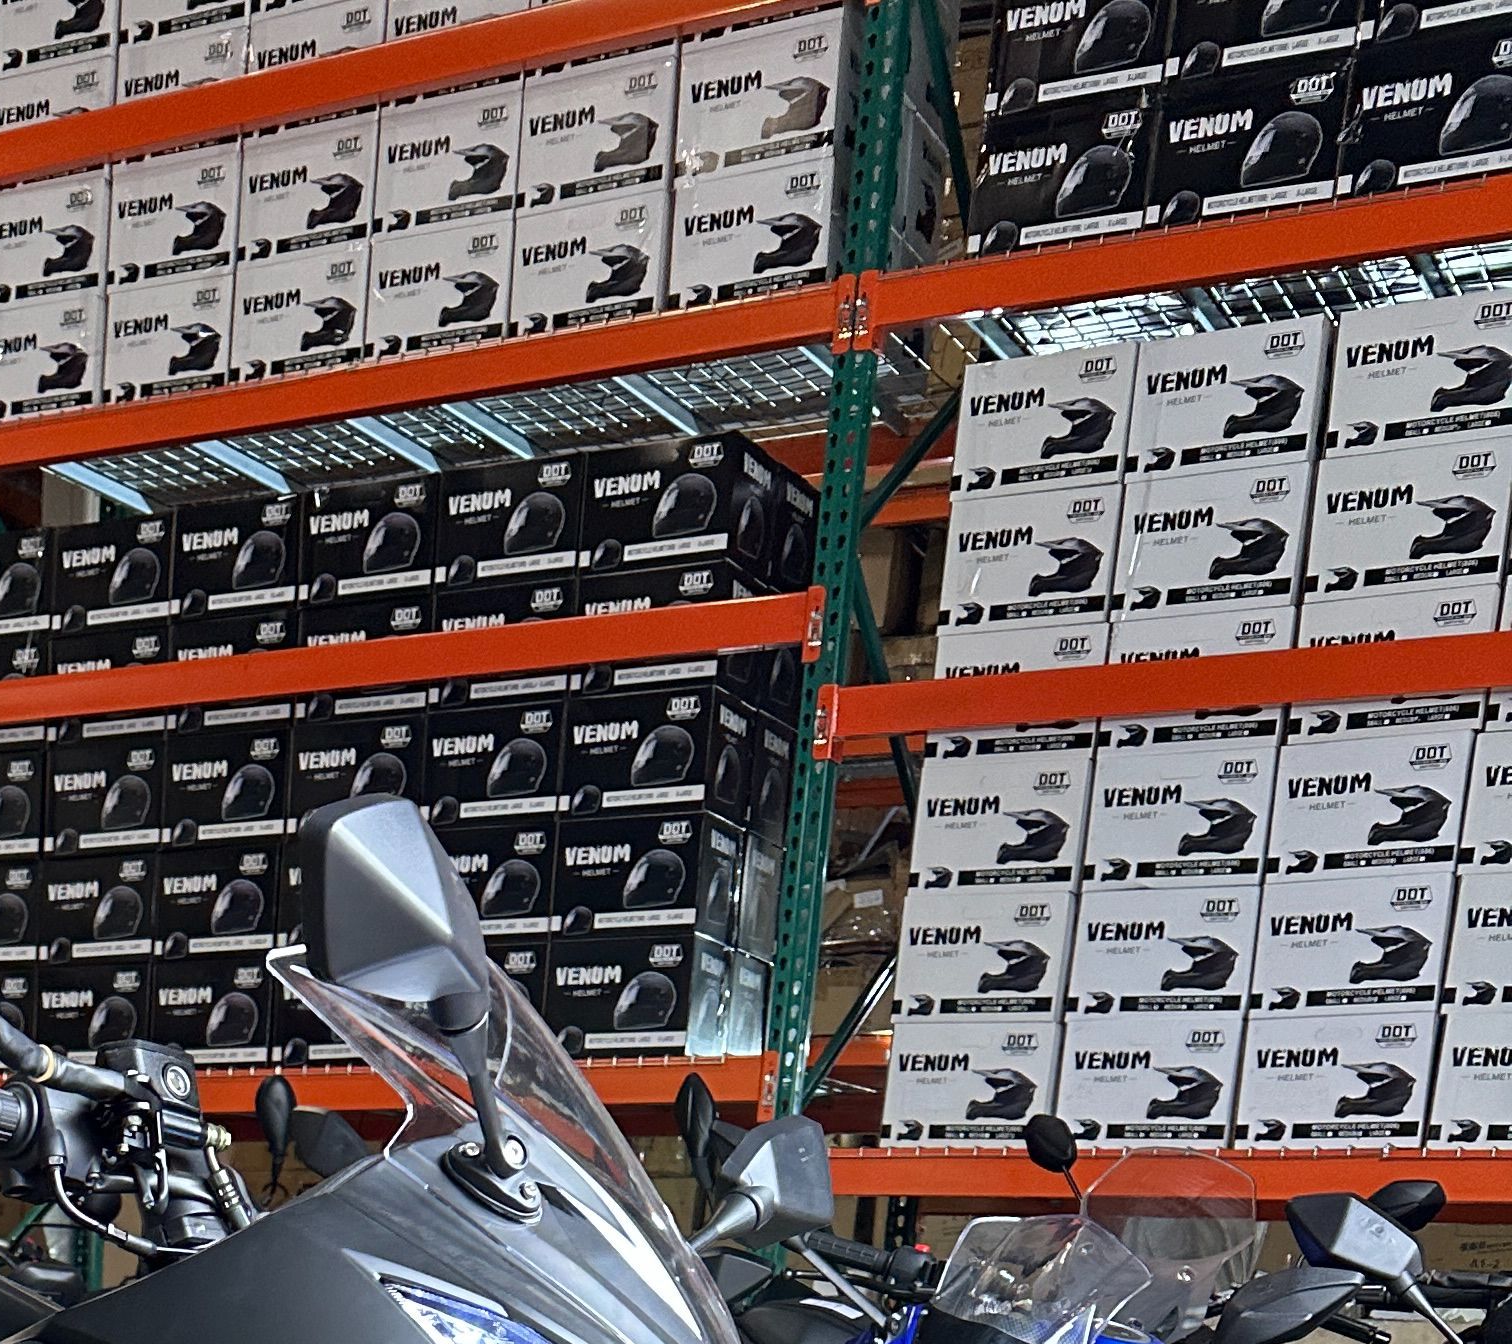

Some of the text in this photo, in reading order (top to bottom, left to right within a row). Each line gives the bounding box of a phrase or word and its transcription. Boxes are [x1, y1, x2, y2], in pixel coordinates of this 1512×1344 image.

[394, 8, 457, 36] VENOM
[1006, 0, 1085, 32] VENOM
[257, 39, 316, 69] VENOM
[124, 70, 179, 98] VENOM
[691, 70, 762, 102] VENOM
[1362, 72, 1453, 111] VENOM
[529, 105, 595, 137] VENOM
[1169, 109, 1253, 143] VENOM
[388, 136, 450, 164] VENOM
[989, 143, 1067, 176] VENOM
[249, 166, 307, 194] VENOM
[118, 193, 173, 219] VENOM
[685, 205, 754, 236] VENOM
[522, 236, 586, 267] VENOM
[379, 262, 441, 289] VENOM
[243, 289, 301, 315] VENOM
[114, 314, 168, 338] VENOM
[1269, 333, 1301, 350] DOT
[1346, 334, 1434, 368] VENOM
[1084, 358, 1113, 373] DOT
[1146, 364, 1228, 395] VENOM
[970, 387, 1045, 417] VENOM
[1460, 453, 1492, 470] DOT
[594, 470, 660, 499] VENOM
[1255, 478, 1286, 494] DOT
[448, 488, 511, 516] VENOM
[1073, 499, 1101, 515] DOT
[1327, 484, 1413, 515] VENOM
[309, 509, 369, 535] VENOM
[1134, 506, 1214, 535] VENOM
[182, 527, 238, 551] VENOM
[958, 526, 1034, 553] VENOM
[62, 545, 115, 569] VENOM
[1440, 601, 1473, 618] DOT
[1241, 621, 1271, 638] DOT
[1059, 637, 1087, 652] DOT
[573, 720, 639, 746] VENOM
[433, 734, 494, 758] VENOM
[1415, 745, 1447, 760] DOT
[172, 760, 227, 782] VENOM
[299, 748, 356, 771] VENOM
[1222, 759, 1254, 776] DOT
[54, 771, 106, 792] VENOM
[1039, 772, 1066, 785] DOT
[1288, 772, 1372, 799] VENOM
[927, 796, 999, 818] VENOM
[1104, 785, 1182, 807] VENOM
[1309, 801, 1346, 811] HELMET
[455, 855, 488, 873] NOM
[565, 844, 630, 867] VENOM
[48, 881, 99, 901] VENOM
[163, 874, 217, 895] VENOM
[1396, 887, 1430, 903] DOT
[1019, 904, 1047, 919] DOT
[1206, 898, 1236, 914] DOT
[909, 925, 982, 946] VENOM
[1088, 920, 1165, 941] VENOM
[1270, 912, 1353, 937] VENOM
[556, 966, 621, 986] VENOM
[42, 991, 93, 1009] VENOM
[159, 987, 212, 1005] VENOM
[1007, 1033, 1035, 1048] DOT
[1192, 1031, 1222, 1045] DOT
[1381, 1025, 1412, 1040] DOT
[899, 1052, 969, 1072] VENOM
[1075, 1050, 1151, 1071] VENOM
[1256, 1048, 1339, 1068] VENOM
